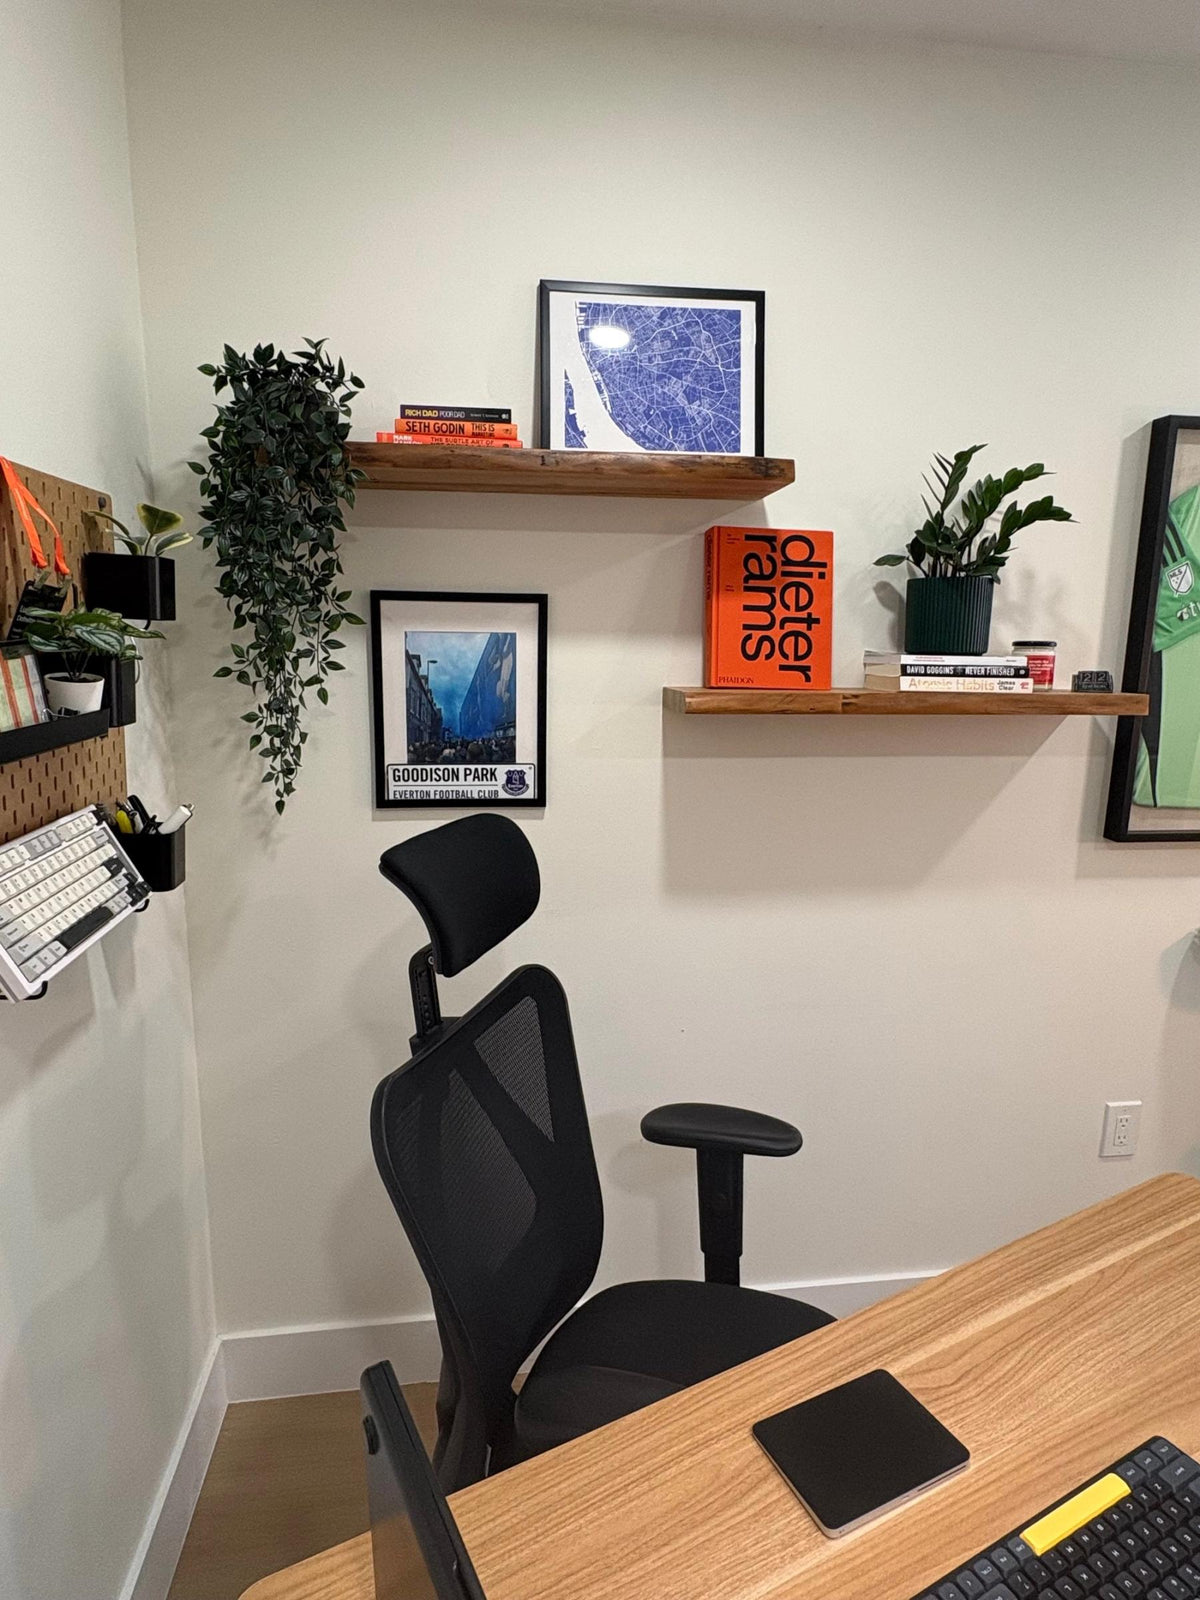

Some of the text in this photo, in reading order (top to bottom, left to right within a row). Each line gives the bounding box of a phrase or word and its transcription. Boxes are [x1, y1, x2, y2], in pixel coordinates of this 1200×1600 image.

[406, 421, 465, 435] SETH GODIN
[471, 423, 495, 432] THIS IS
[741, 533, 777, 661] rams
[778, 534, 828, 683] dieter
[906, 666, 1015, 676] DAVID GOGGINS NEVER FINISHED
[718, 676, 754, 684] PHAIDON
[956, 679, 995, 690] Habits
[392, 767, 498, 782] GOODISON PARK
[393, 790, 431, 799] EVERTON
[434, 790, 475, 799] FOOTBALL
[478, 790, 499, 798] CLUB
